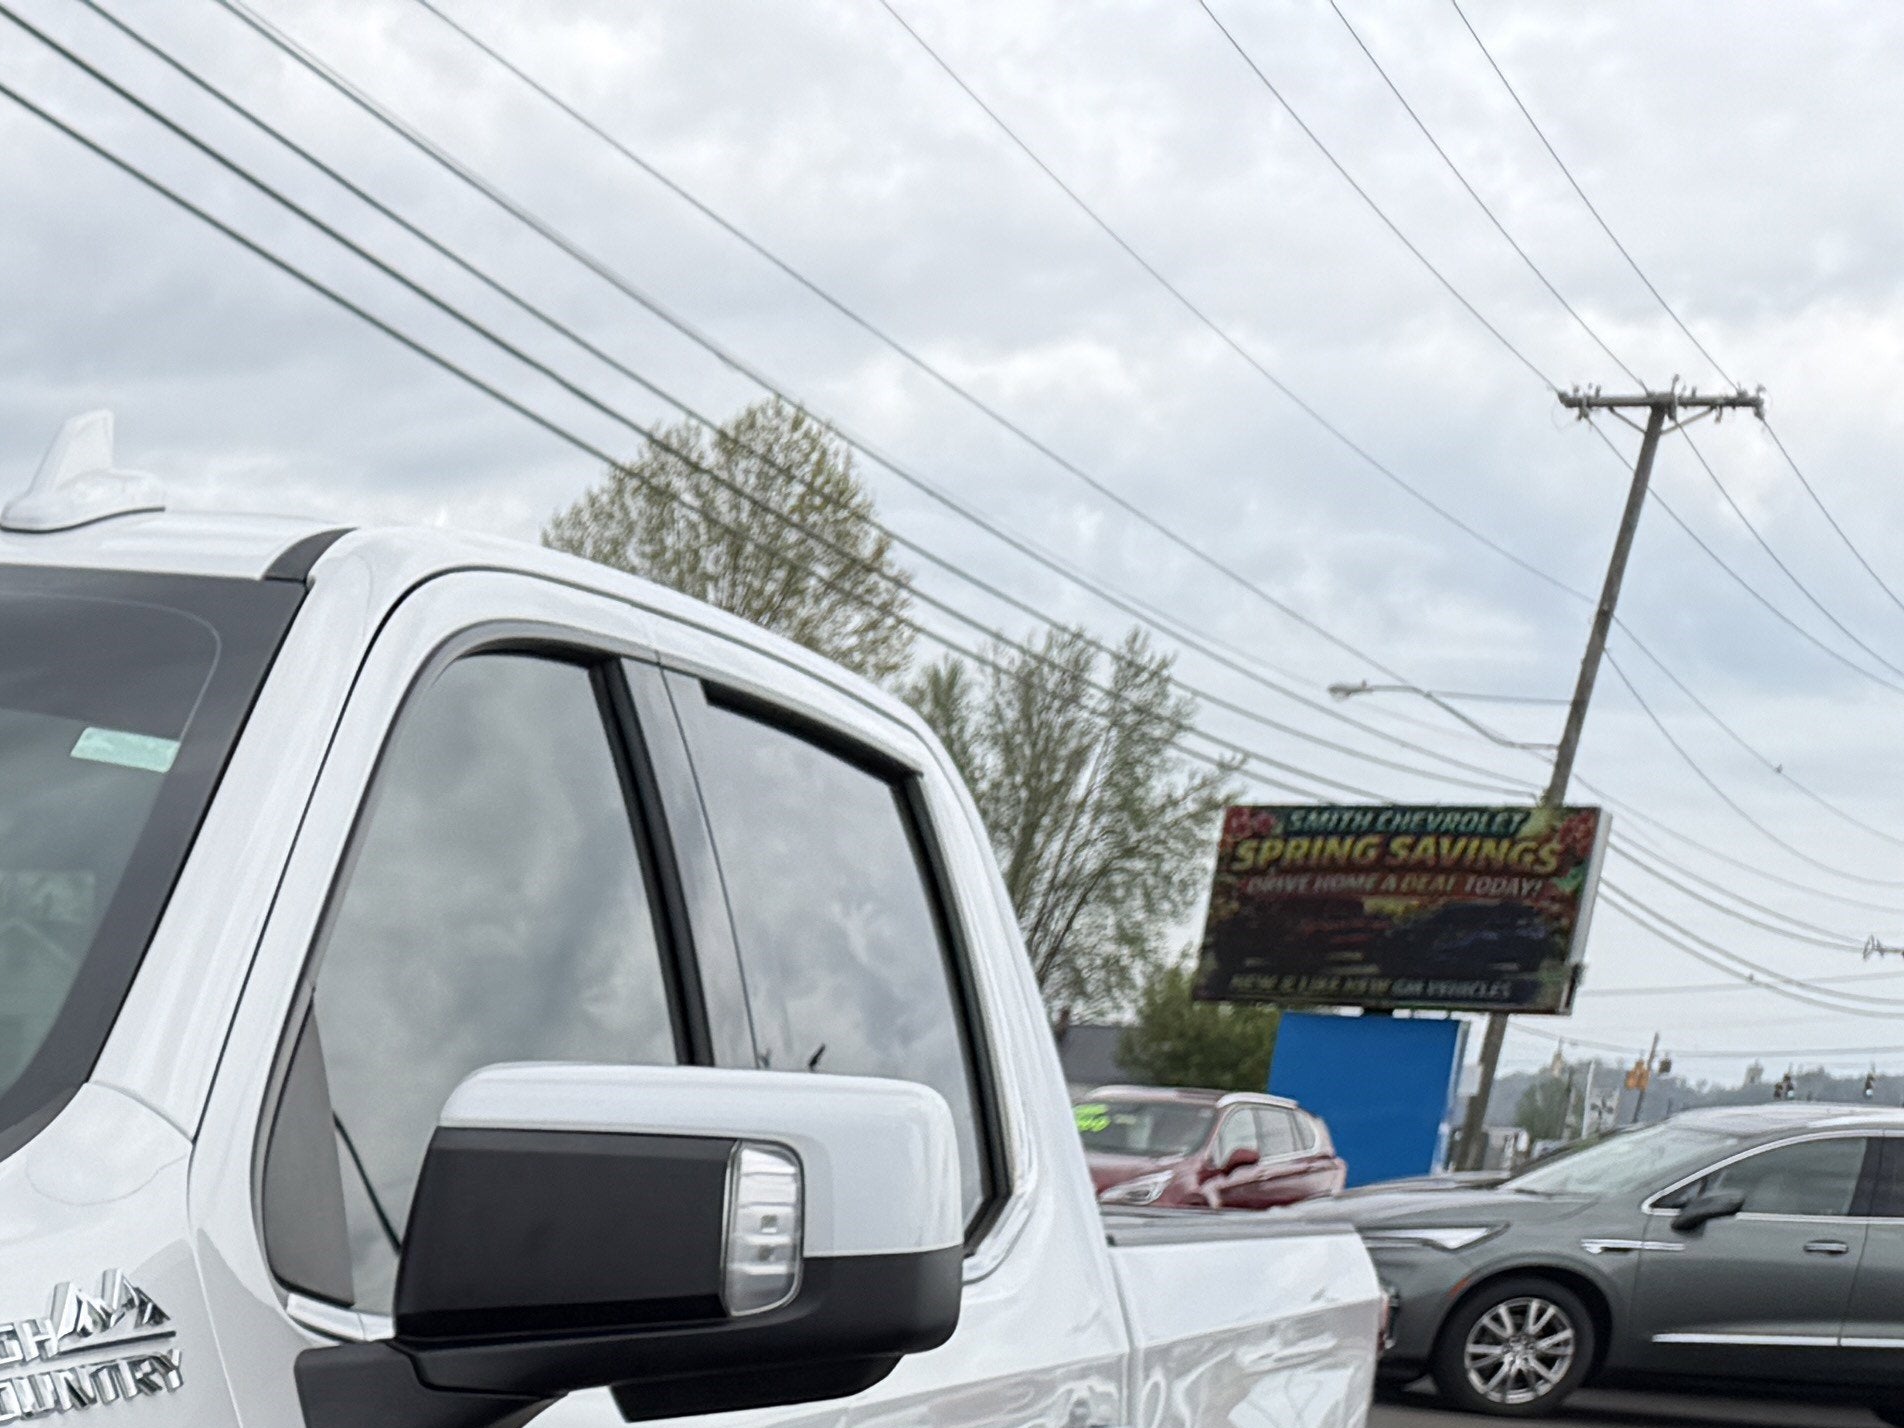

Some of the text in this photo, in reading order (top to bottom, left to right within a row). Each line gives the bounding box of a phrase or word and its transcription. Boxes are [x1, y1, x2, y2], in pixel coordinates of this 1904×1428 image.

[1290, 807, 1531, 835] SMITH CHEVROLET
[1231, 835, 1563, 875] SPRING SAVINGS
[1463, 874, 1542, 899] TODAY!
